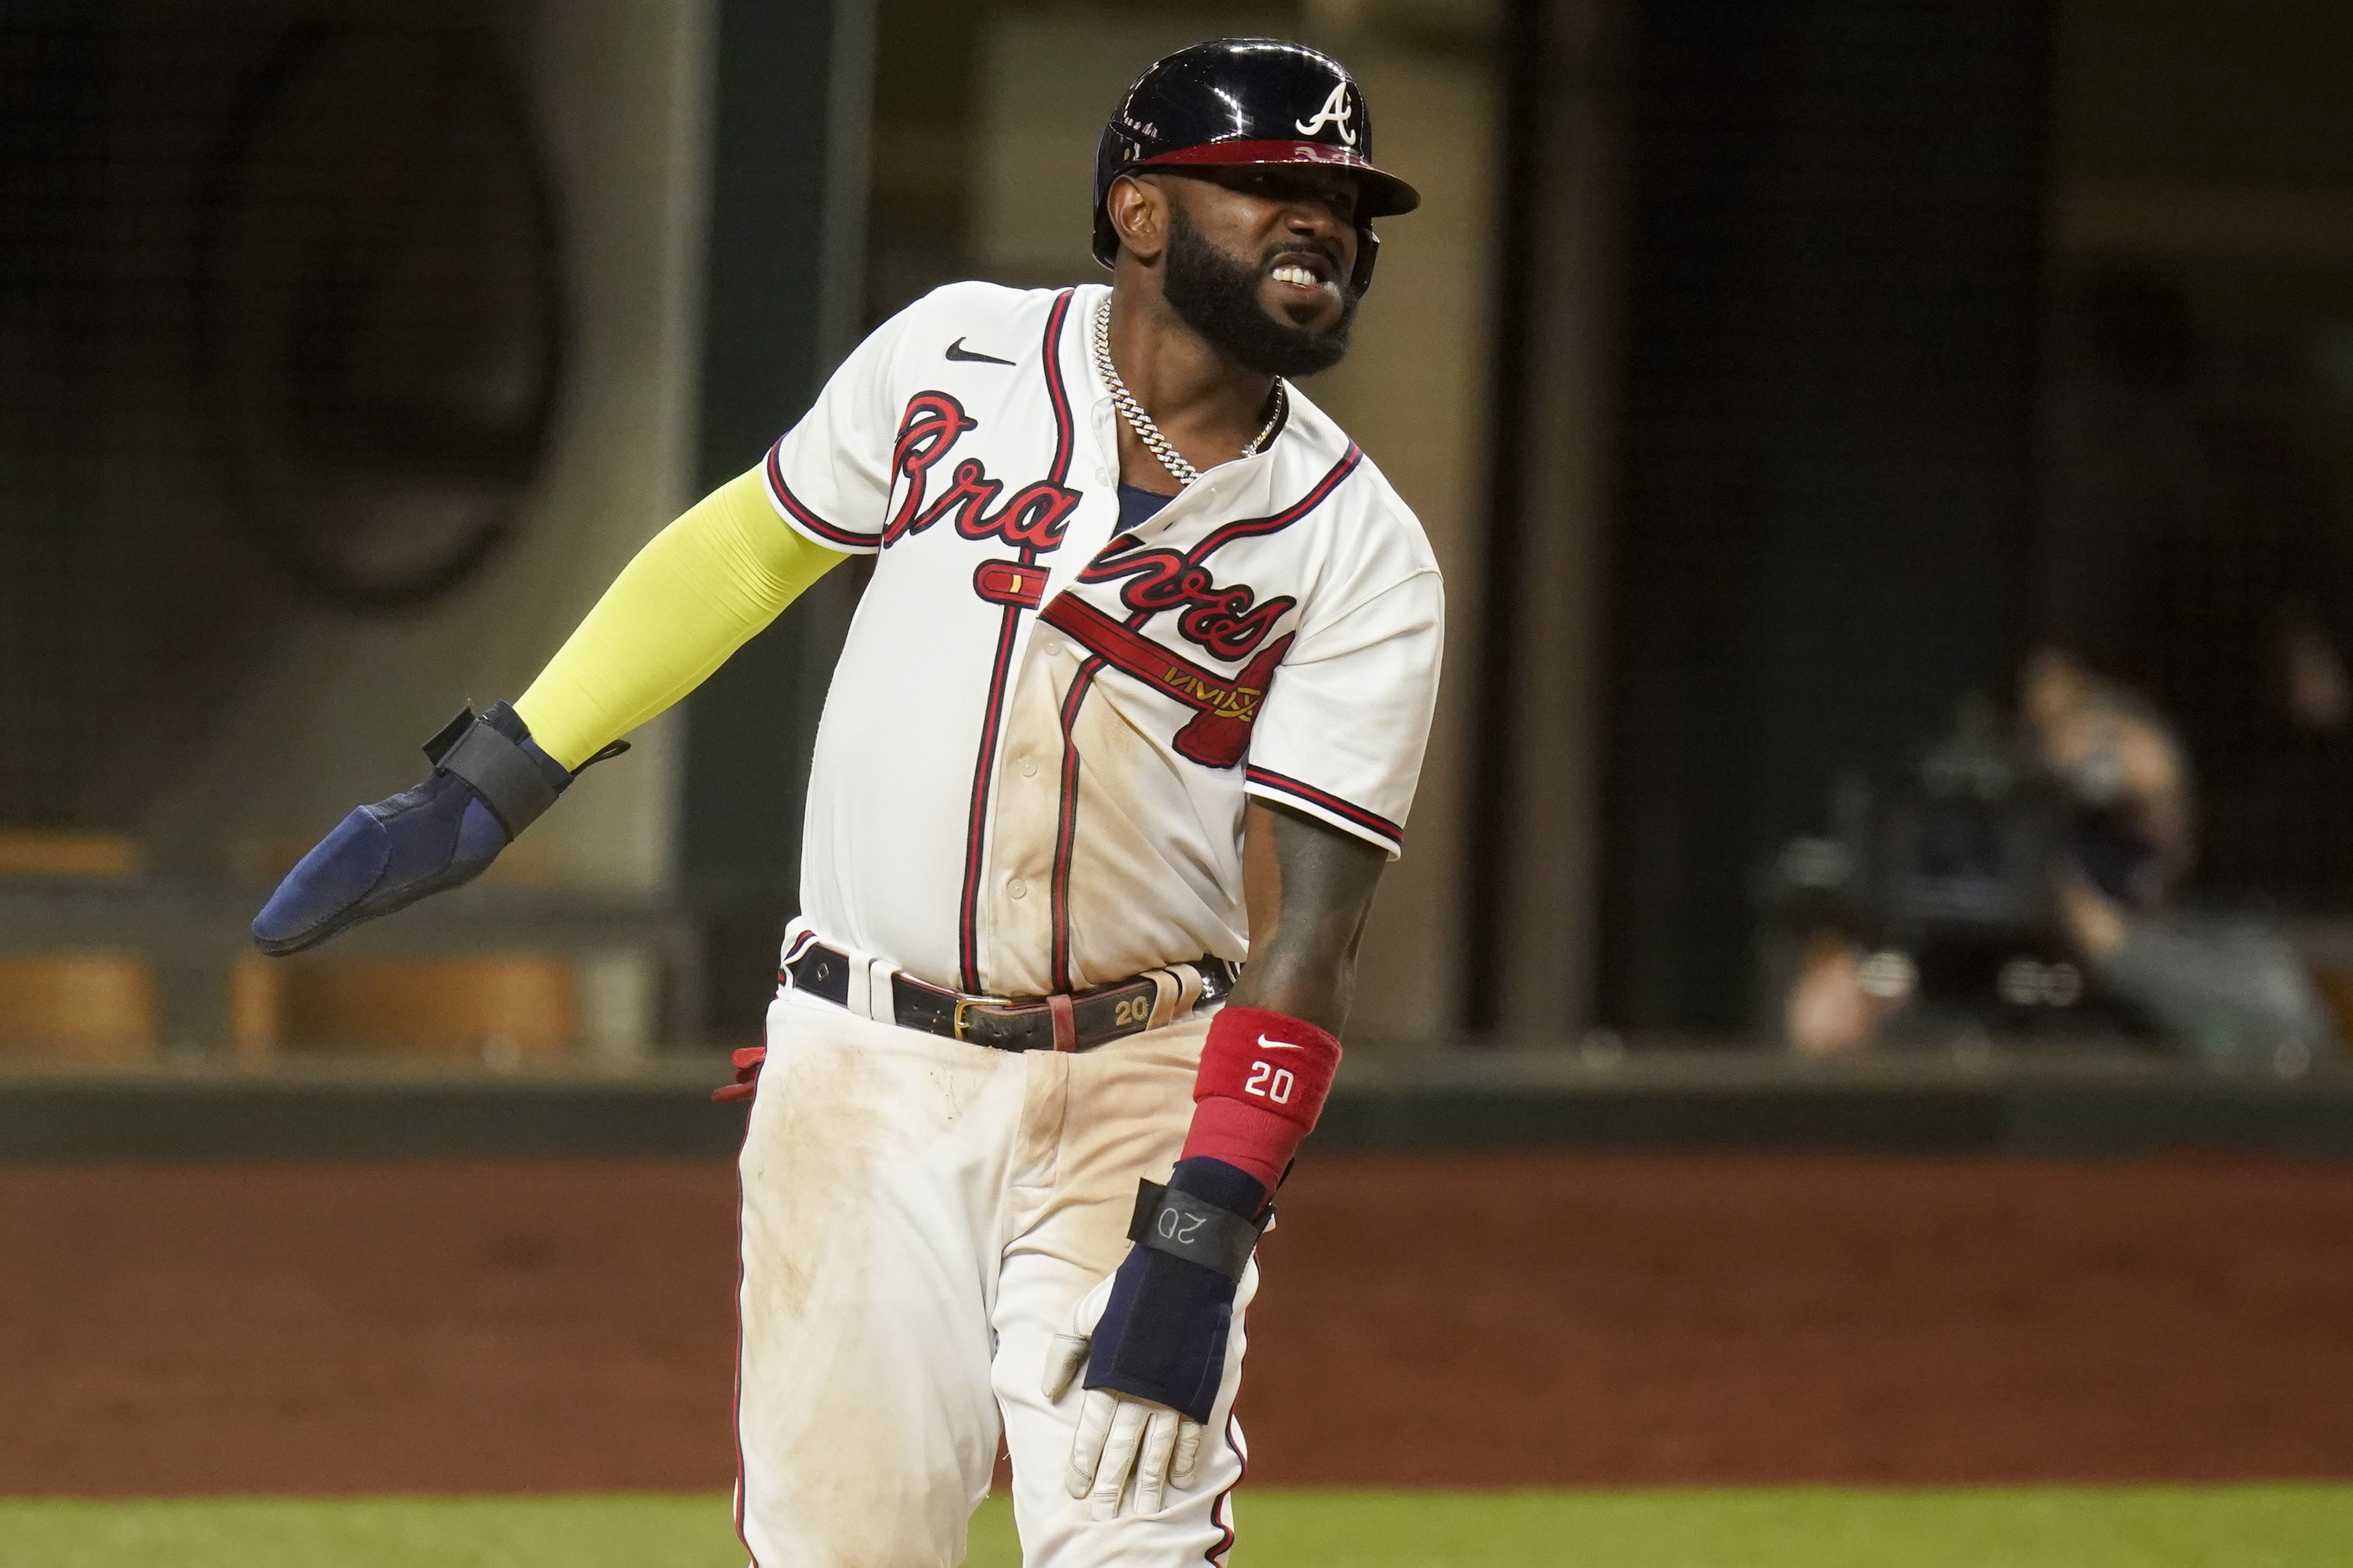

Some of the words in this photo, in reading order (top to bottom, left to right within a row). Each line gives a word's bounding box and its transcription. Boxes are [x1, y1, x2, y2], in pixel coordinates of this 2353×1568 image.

[1295, 81, 1356, 145] A
[1115, 996, 1149, 1026] 20
[1245, 1061, 1294, 1104] 20
[1158, 1207, 1207, 1245] 20
